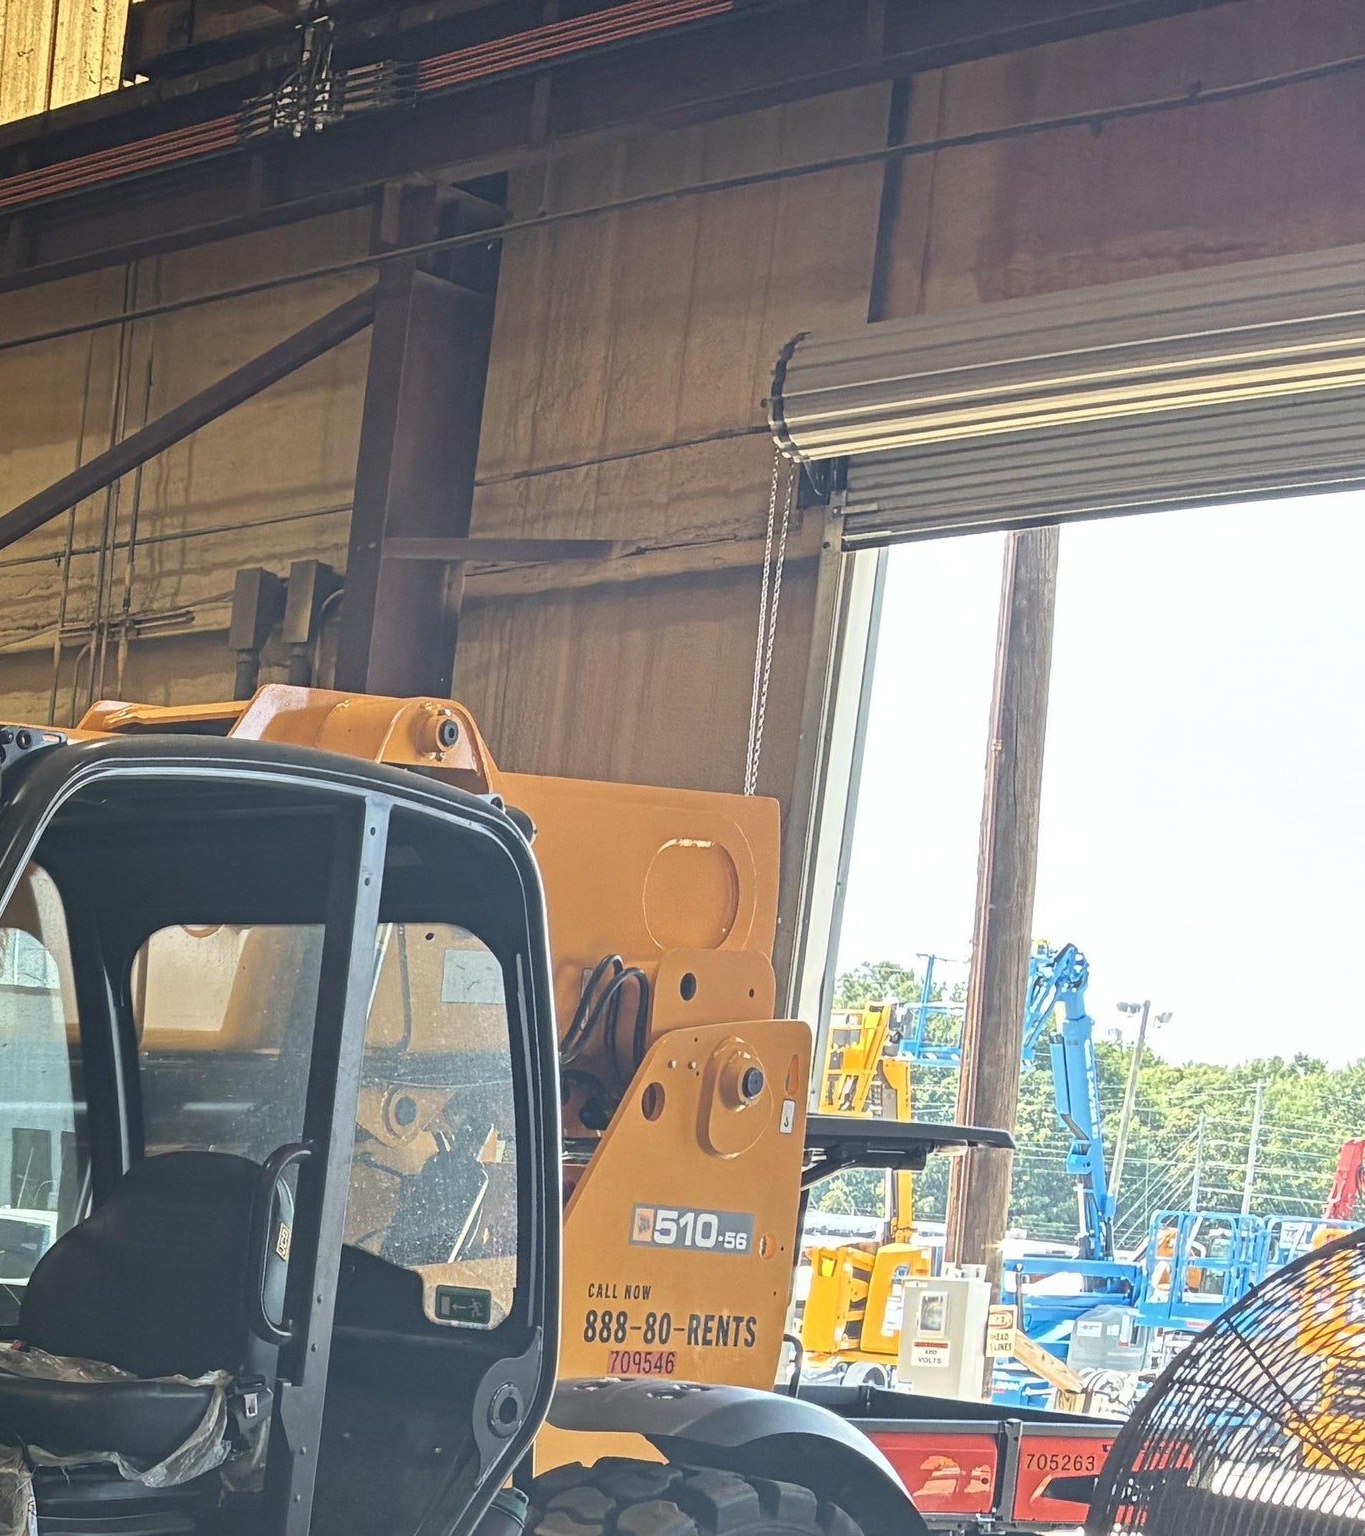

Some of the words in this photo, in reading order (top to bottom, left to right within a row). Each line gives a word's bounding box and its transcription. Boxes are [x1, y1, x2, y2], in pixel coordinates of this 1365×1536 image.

[588, 1283, 617, 1299] CALL
[624, 1285, 652, 1300] NOW
[583, 1309, 757, 1348] 888-80-RENTS
[609, 1350, 677, 1375] 709546
[1026, 1453, 1096, 1472] 705263
